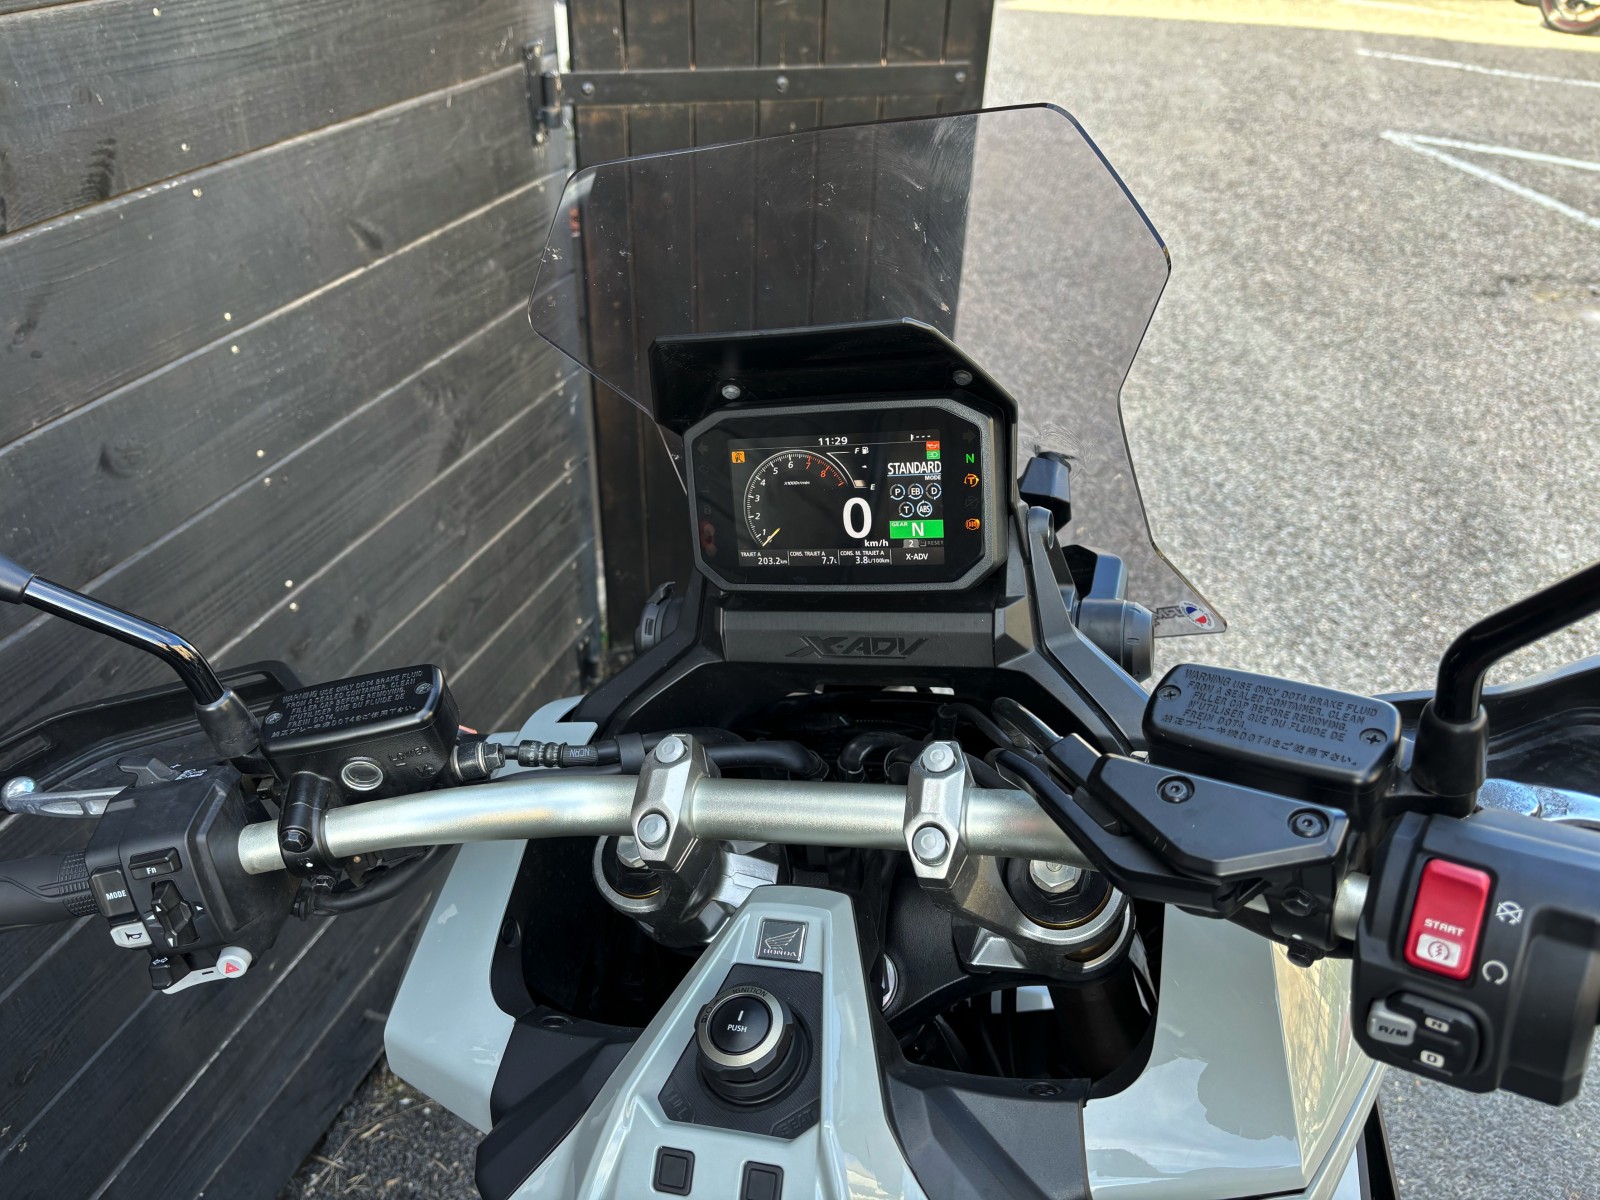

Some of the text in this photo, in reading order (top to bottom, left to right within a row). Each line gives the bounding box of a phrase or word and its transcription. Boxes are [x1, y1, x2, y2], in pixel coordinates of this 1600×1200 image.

[818, 437, 848, 446] 11:29
[966, 454, 974, 464] N
[888, 461, 942, 474] STANDARD
[843, 497, 872, 539] 0
[911, 522, 924, 536] N
[785, 636, 929, 659] X-ADV
[356, 680, 374, 688] DOT4
[376, 675, 400, 684] BRAKE
[402, 670, 423, 679] FLUID
[1185, 668, 1378, 717] WARNING USE ONLY DOT4 BRAKE FLUID
[291, 704, 317, 714] FILLER
[320, 700, 334, 708] CAP
[336, 694, 365, 706] BEFORE
[353, 701, 363, 709] DU
[1187, 680, 1214, 692] FROM
[1224, 688, 1264, 703] SEALED
[1267, 697, 1324, 717] CONTAINER.
[1328, 710, 1365, 724] CLEAN
[1183, 709, 1214, 722] FREIN
[1193, 691, 1348, 732] FILLER CAP BEFORE REMOVING.
[1188, 700, 1346, 742] N'UTILISER QUE DU FLUIDE DE
[106, 890, 127, 900] MODE
[1424, 918, 1464, 936] START
[764, 948, 796, 957] HONDA
[733, 987, 768, 998] IGNITION
[727, 1024, 748, 1032] PUSH
[1430, 1021, 1443, 1029] N
[1426, 1054, 1438, 1063] D
